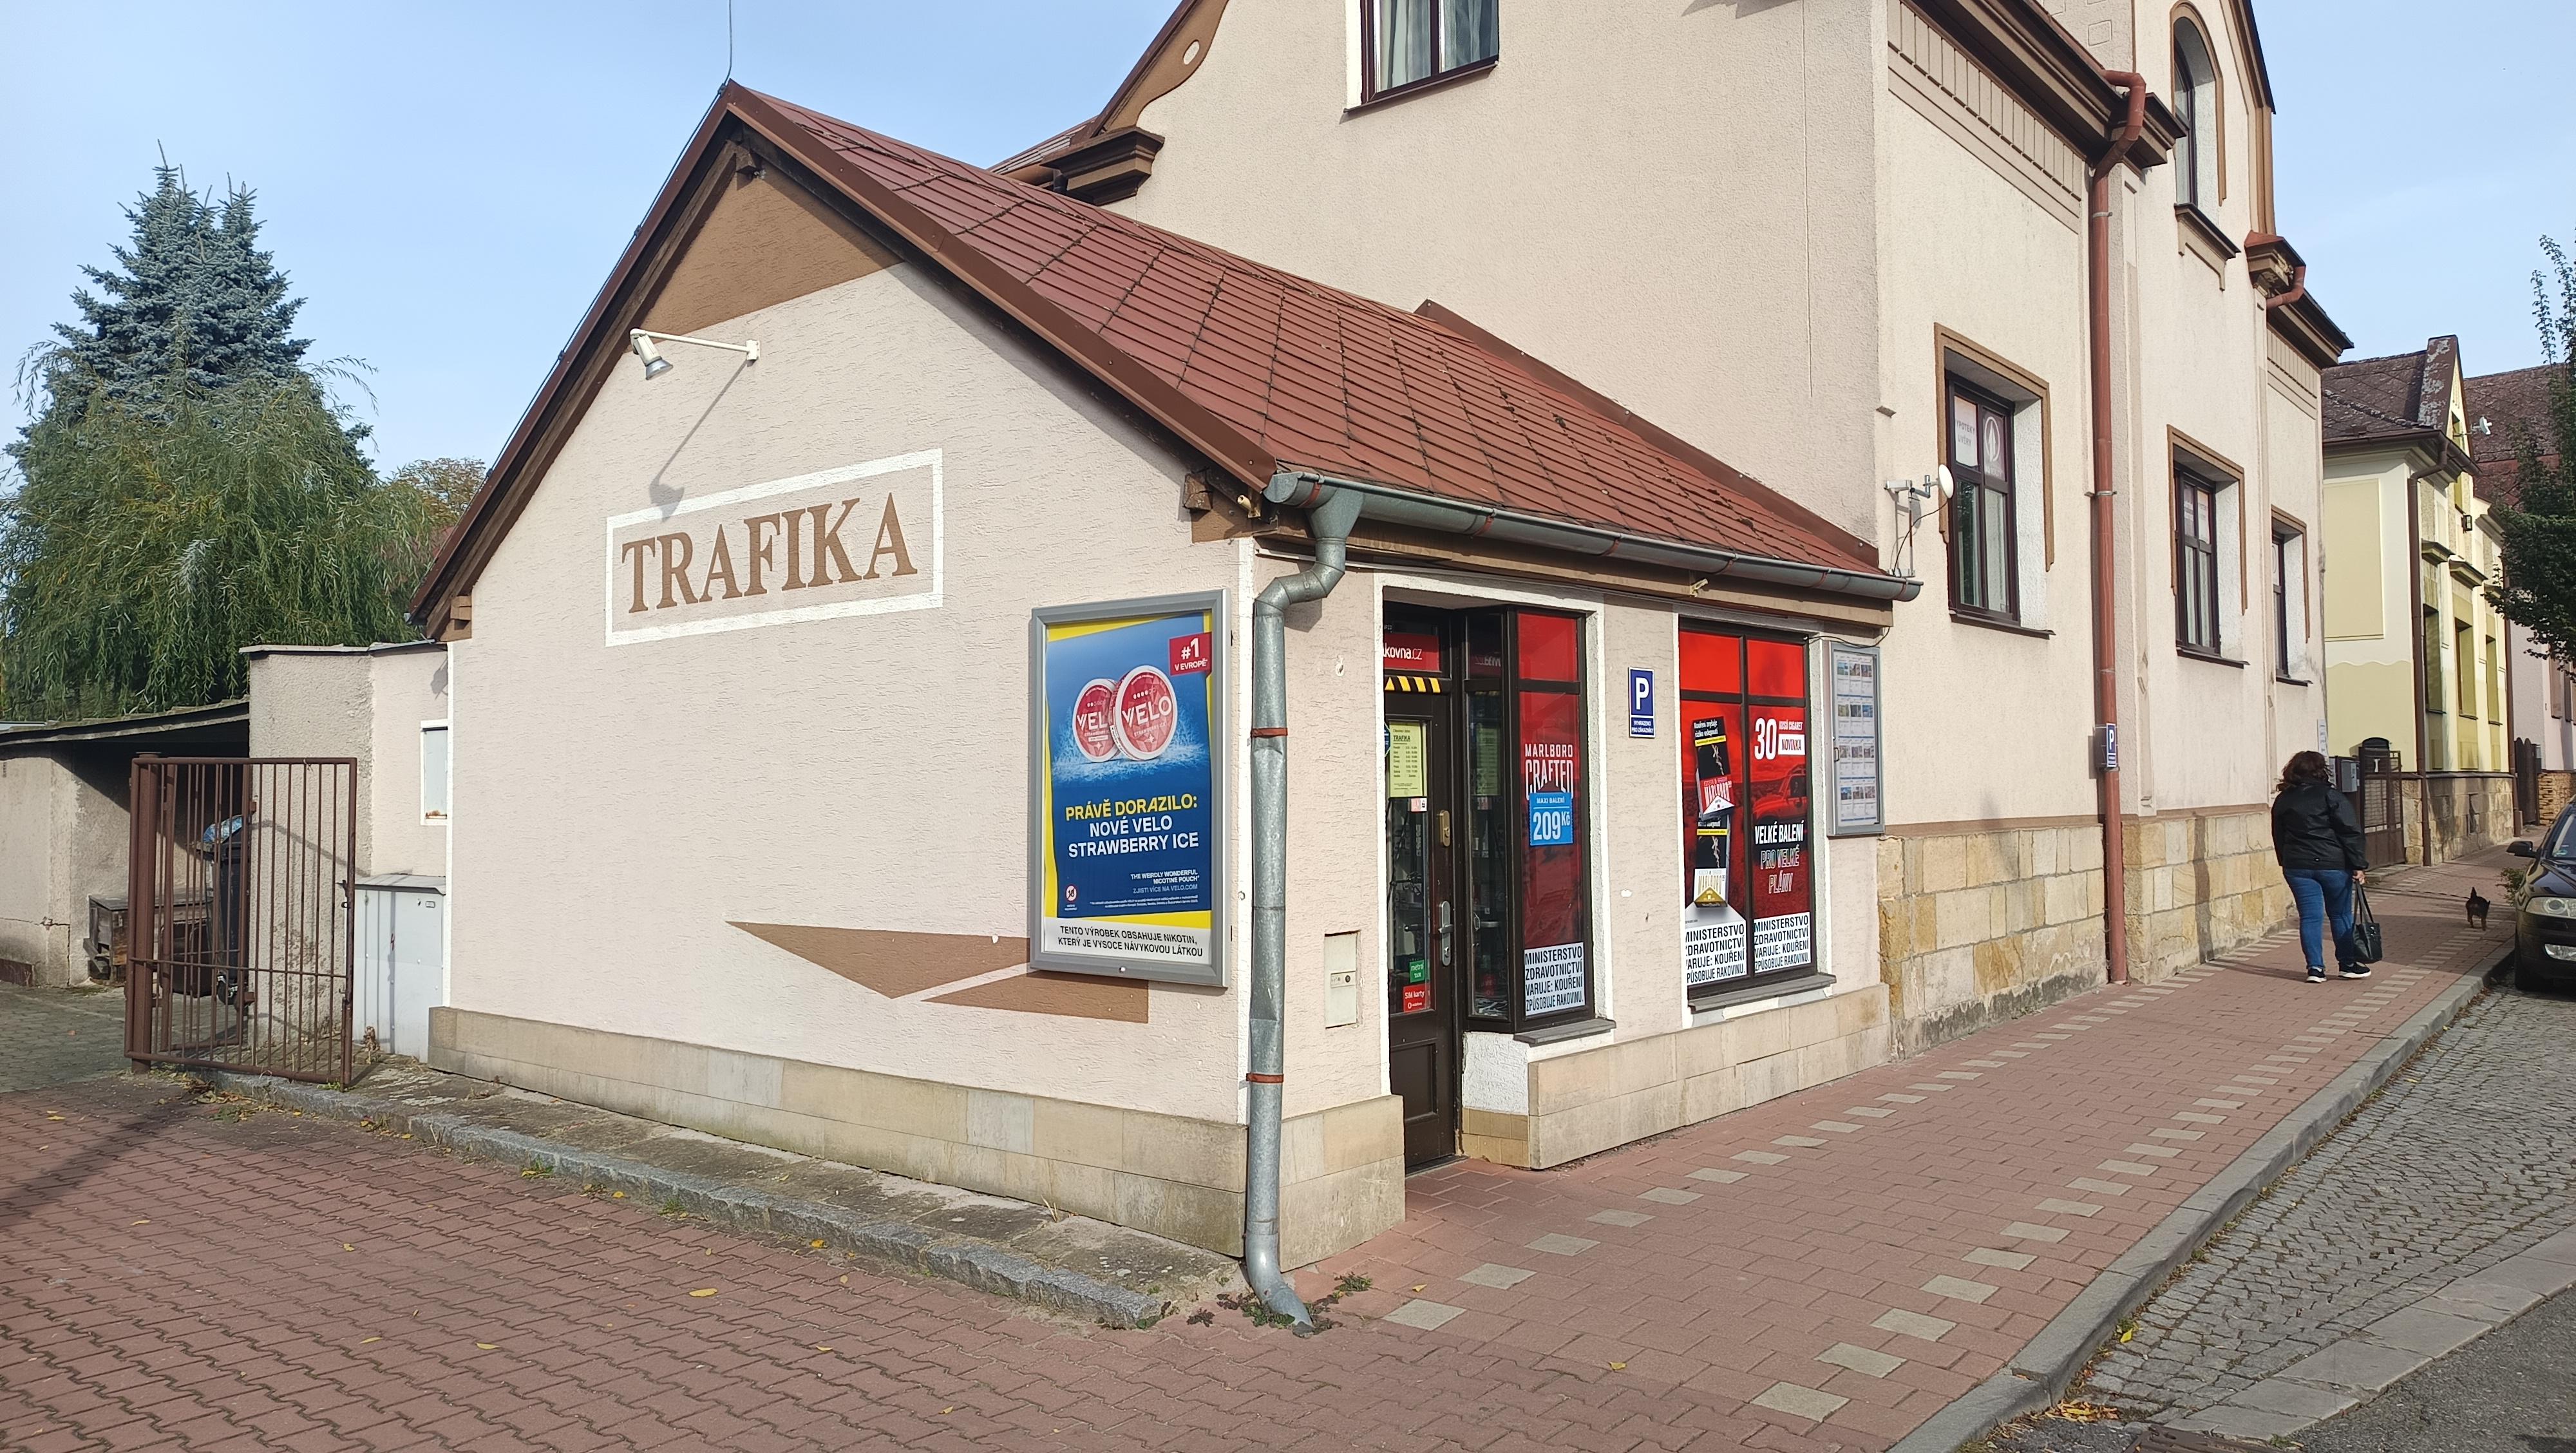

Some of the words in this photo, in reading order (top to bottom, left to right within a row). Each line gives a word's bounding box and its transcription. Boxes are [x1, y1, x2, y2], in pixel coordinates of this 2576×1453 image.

[621, 492, 918, 613] TRAFIKA
[1180, 638, 1199, 660] #1
[1383, 642, 1422, 660] kovna.cz
[1636, 677, 1649, 710] P
[1077, 712, 1108, 731] VEL
[1122, 696, 1172, 728] VELO
[1754, 718, 1777, 759] 30
[1781, 739, 1802, 751] NOVINKA
[2109, 729, 2114, 750] P
[1525, 743, 1573, 757] MARLBORO
[1525, 759, 1573, 801] CRAFTED
[1066, 799, 1112, 821] PRÁVĚ
[1115, 793, 1197, 816] DORAZILO:
[1090, 816, 1129, 837] NOVÉ
[1132, 815, 1173, 833] VELO
[1533, 812, 1561, 840] 209
[1561, 811, 1570, 826] Kč
[1755, 821, 1777, 844] VELKÉ
[1779, 820, 1804, 842] BALENÍ
[1068, 835, 1170, 858] STRAWBERRY
[1173, 832, 1198, 849] ICE
[1761, 849, 1776, 869] PRO
[1777, 844, 1799, 868] VELKÉ
[1164, 869, 1198, 877] WONDERFUL
[1768, 870, 1793, 894] PLÁNY
[1754, 915, 1808, 933] MINISTERSTVO
[1057, 936, 1081, 947] KTERÝ
[1083, 939, 1091, 947] JE
[1093, 940, 1122, 950] VYSOCE
[1124, 941, 1170, 954] NÁVYKOVOU
[1172, 945, 1203, 956] LÁTKOU
[1060, 926, 1083, 935] TENTO
[1084, 926, 1119, 938] VÝROBEK
[1121, 931, 1162, 941] OBSAHUJE
[1164, 933, 1197, 945] NIKOTIN,
[1686, 935, 1745, 956] DRAVOTNICTVÍ
[1754, 926, 1808, 945] ZDRAVOTNICTVÍ
[1525, 946, 1582, 965] MINISTERSTVO
[1755, 946, 1781, 958] VARUJE:
[1783, 938, 1809, 954] KOUŘENÍ
[1526, 958, 1582, 980] ZDRAVOTNICTVÍ
[1686, 956, 1712, 970] ARUJE:
[1714, 948, 1745, 965] KOUŘENÍ
[1755, 956, 1783, 971] ZPŮSOBUJE
[1784, 951, 1810, 966] RAKOVINU.
[1687, 967, 1715, 983] PŮSOBUJE
[1716, 964, 1745, 978] RAKOVINU.
[1526, 981, 1553, 996] VARUJE:
[1555, 974, 1582, 992] KOUŘENÍ
[1526, 995, 1555, 1012] ZPŮSOBUJE
[1557, 991, 1584, 1006] RAKOVINU.
